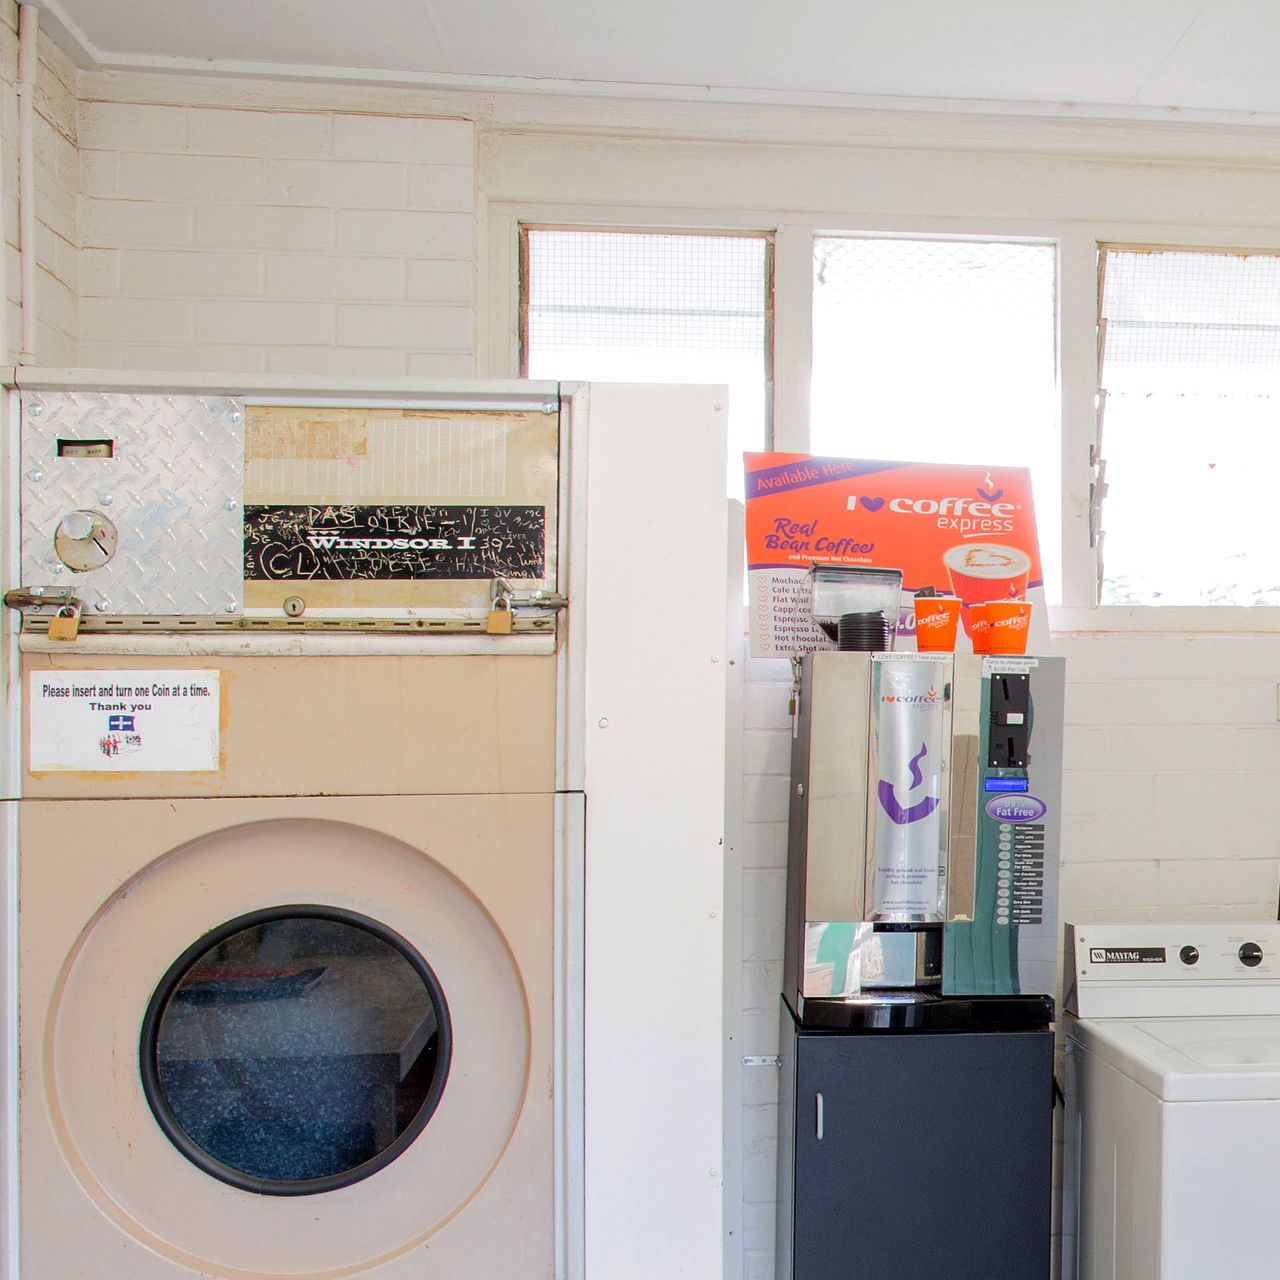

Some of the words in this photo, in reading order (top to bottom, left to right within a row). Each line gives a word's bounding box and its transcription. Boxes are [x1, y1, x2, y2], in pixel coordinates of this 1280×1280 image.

[757, 467, 819, 490] Available
[822, 459, 856, 477] Here
[846, 495, 857, 510] I
[889, 497, 1016, 518] coffee
[773, 517, 819, 538] Real
[937, 516, 1014, 533] express
[306, 536, 453, 549] WINDSOR
[457, 536, 476, 549] I
[765, 534, 810, 553] Bean
[814, 536, 875, 555] Coffee
[917, 611, 950, 625] coffee
[995, 615, 1028, 628] coffee
[42, 684, 70, 697] Please
[72, 684, 96, 697] insert
[98, 684, 114, 697] and
[115, 685, 133, 697] turn
[135, 687, 150, 697] one
[152, 684, 170, 697] Coin
[172, 685, 181, 697] at
[182, 687, 188, 697] a
[190, 684, 210, 697] time.
[896, 695, 941, 704] coffee
[89, 702, 127, 711] Thank
[130, 703, 152, 712] you
[996, 808, 1012, 816] Fat
[1014, 808, 1034, 816] Free
[1106, 952, 1140, 960] MAYTAG
